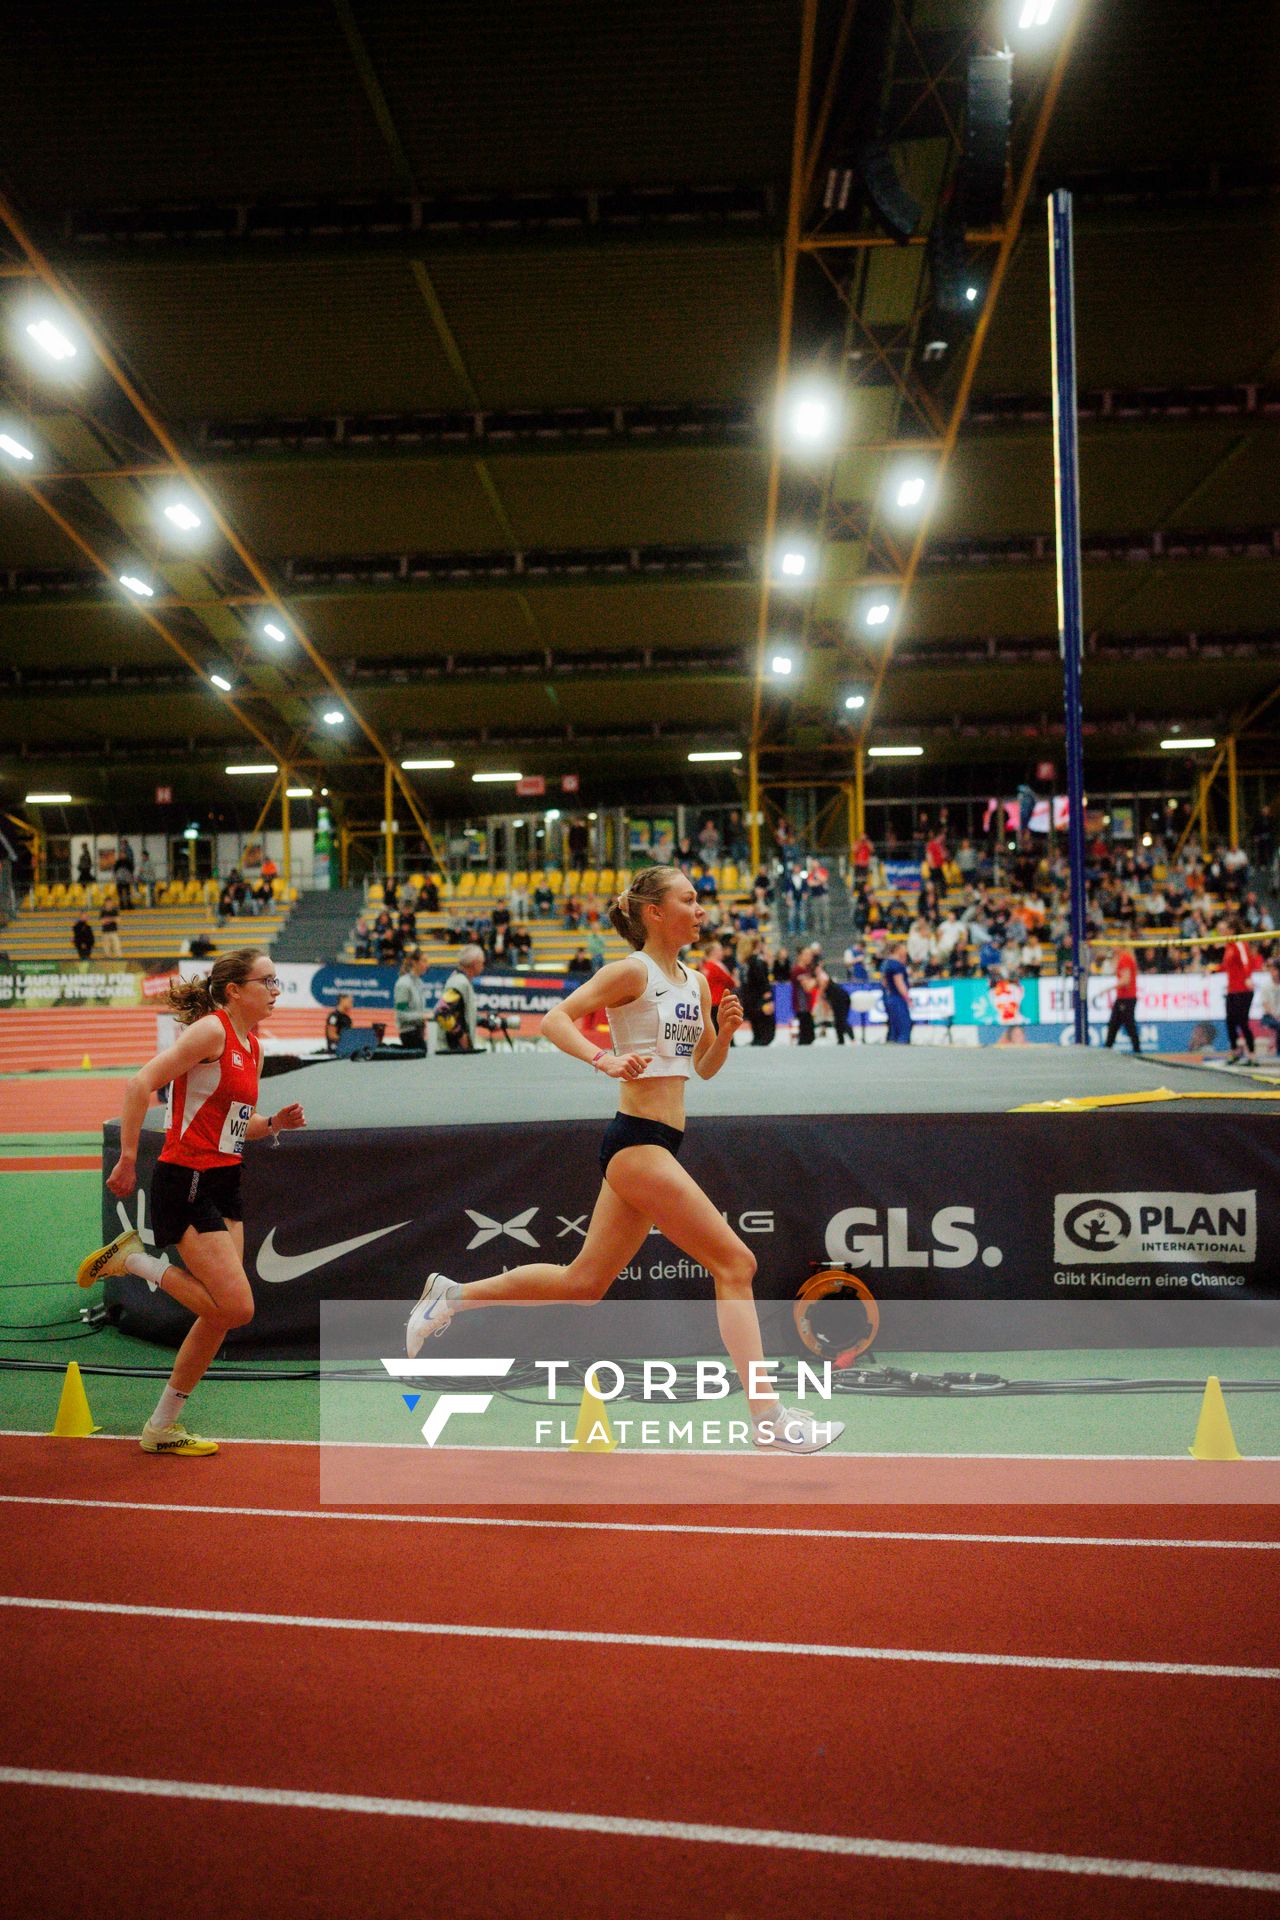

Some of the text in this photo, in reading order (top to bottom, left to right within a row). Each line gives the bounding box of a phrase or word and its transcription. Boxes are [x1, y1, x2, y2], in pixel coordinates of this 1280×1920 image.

[675, 1003, 699, 1021] GLS
[1140, 1206, 1247, 1236] PLAN
[1142, 1242, 1245, 1253] INTERNATIONAL
[89, 1243, 119, 1278] BROOKS
[617, 1265, 642, 1281] eu
[1054, 1272, 1246, 1286] Gibt Kindern eine Chance
